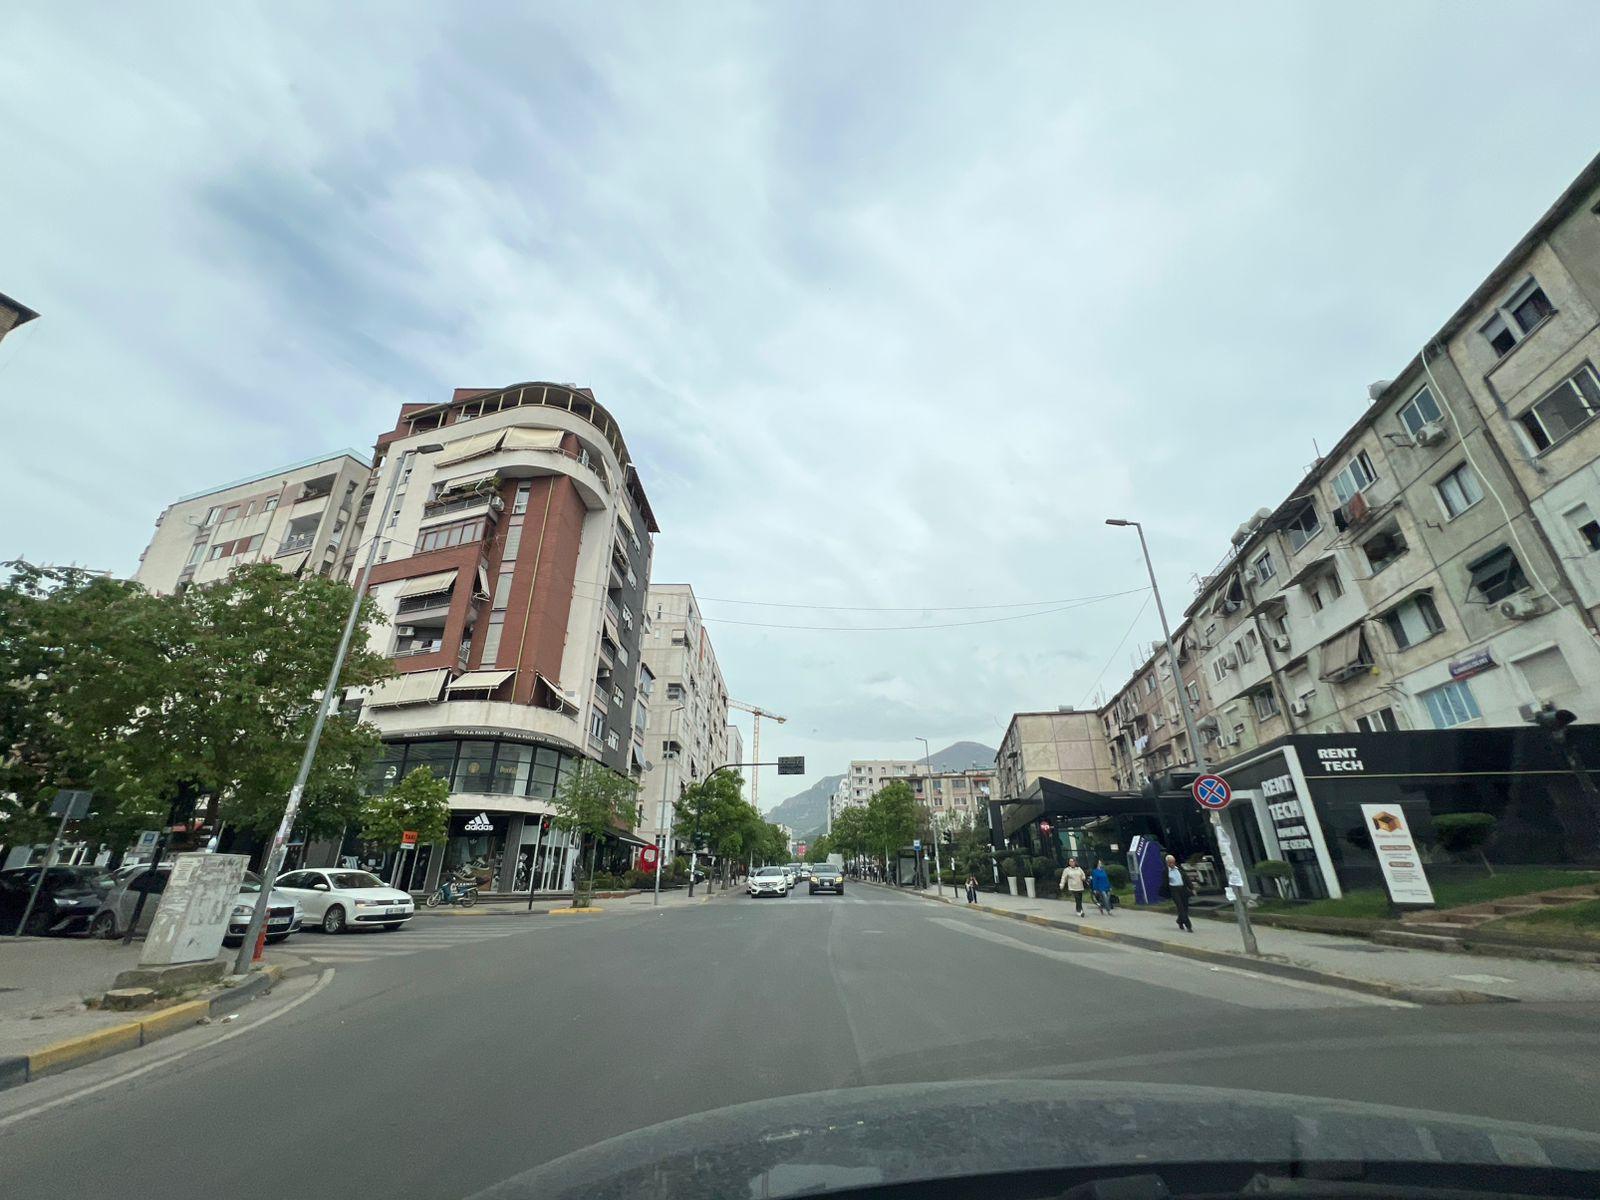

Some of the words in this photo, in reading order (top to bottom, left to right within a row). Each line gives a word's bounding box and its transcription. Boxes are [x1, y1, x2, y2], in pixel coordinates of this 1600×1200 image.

[1317, 748, 1357, 759] RENT
[1321, 760, 1364, 771] TECH
[1261, 774, 1294, 797] RENT
[1268, 800, 1304, 820] TECH
[464, 823, 494, 831] adidas
